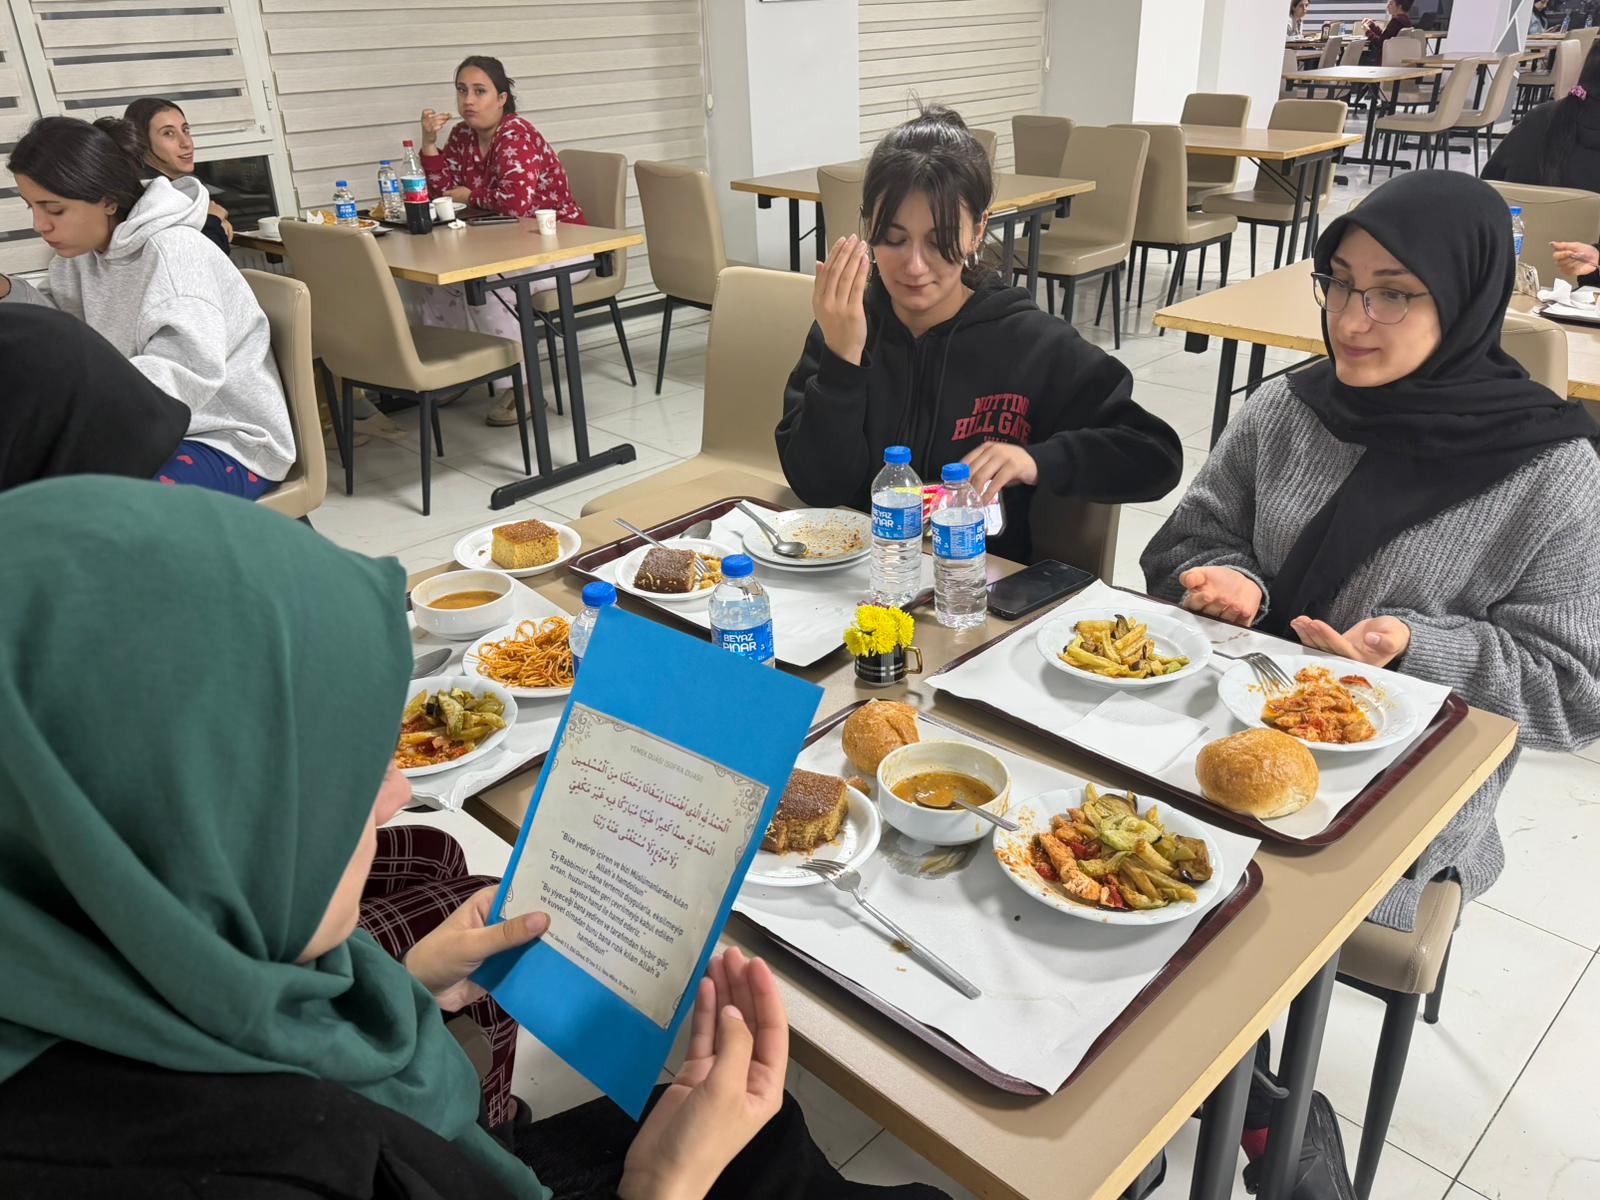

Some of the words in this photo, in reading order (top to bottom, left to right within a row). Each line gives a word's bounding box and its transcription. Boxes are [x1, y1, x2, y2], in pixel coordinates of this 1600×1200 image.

[972, 393, 1029, 416] NOTTIN
[951, 411, 995, 441] HILL
[722, 641, 757, 653] PINAR
[723, 633, 754, 643] BEYAZ
[559, 854, 589, 875] Rabbimiz!
[588, 870, 603, 885] Sana
[602, 879, 625, 898] tertemiz
[613, 861, 620, 869] ve
[549, 864, 566, 878] artan,
[567, 872, 601, 896] huzurundan
[599, 893, 611, 903] geri
[639, 917, 655, 933] kabul
[654, 928, 674, 944] edilen
[573, 901, 586, 914] bana
[584, 910, 604, 926] yediren
[603, 923, 610, 931] ve
[587, 896, 603, 911] hamd
[601, 906, 609, 916] ile
[608, 910, 625, 926] hamd
[540, 895, 547, 903] ve
[547, 897, 566, 914] kuvvet
[565, 910, 586, 928] olmadan
[585, 923, 599, 937] bunu
[598, 932, 611, 946] bana
